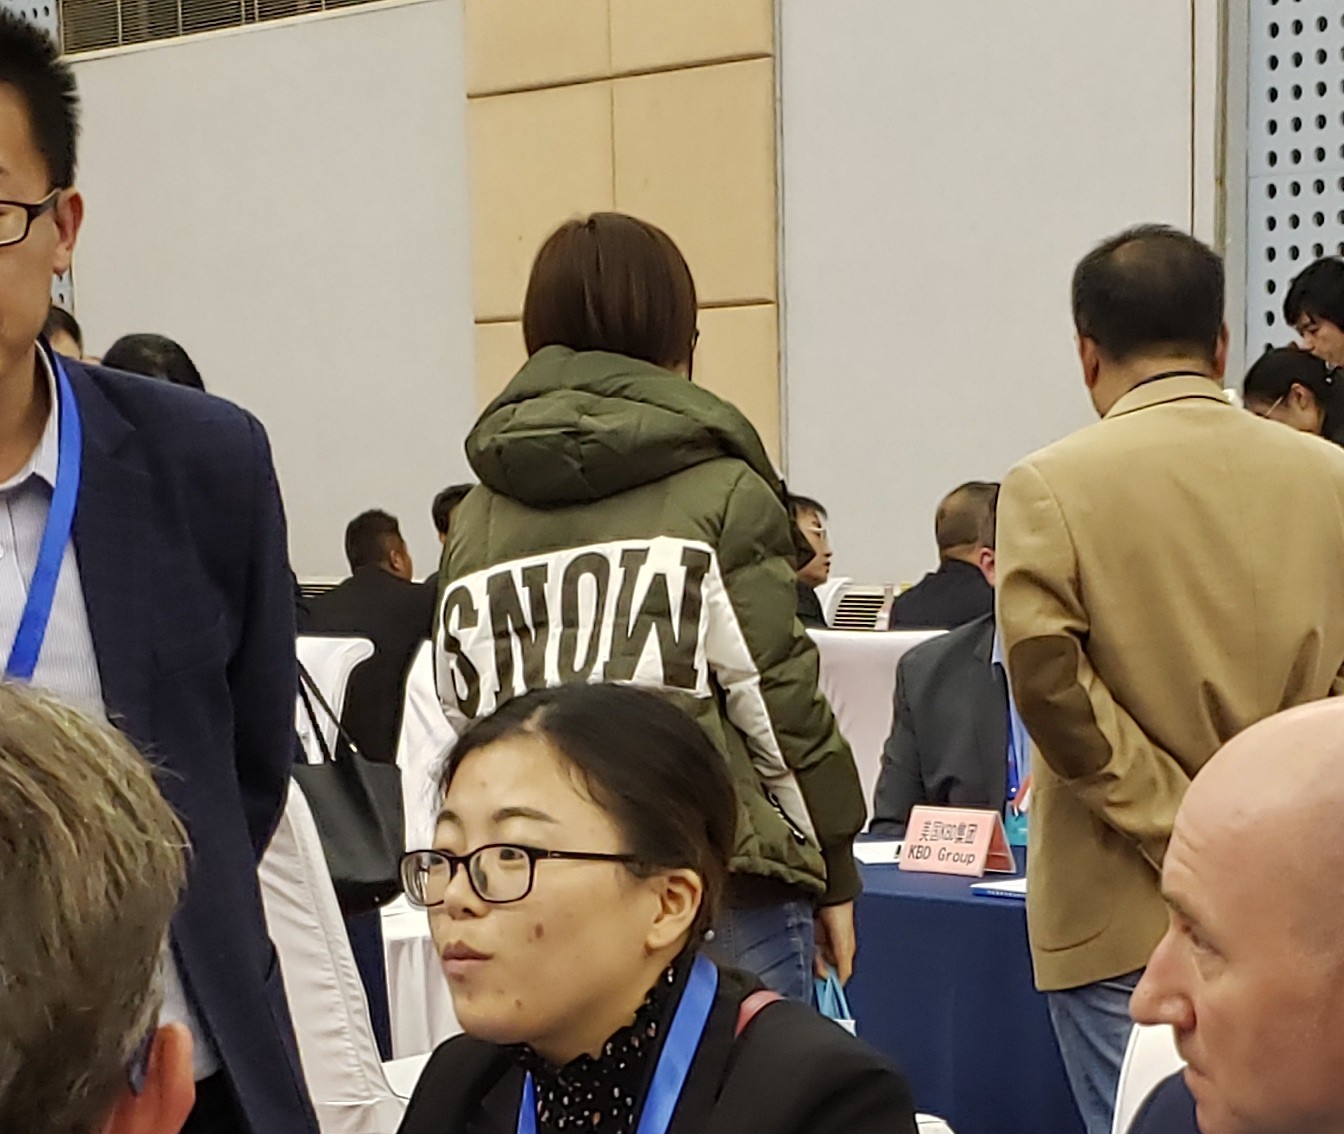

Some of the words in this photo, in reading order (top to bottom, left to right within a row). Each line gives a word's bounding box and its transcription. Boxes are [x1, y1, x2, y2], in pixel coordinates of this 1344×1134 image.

[442, 546, 711, 719] SNOW
[908, 845, 932, 860] KBD
[937, 848, 976, 866] Group
